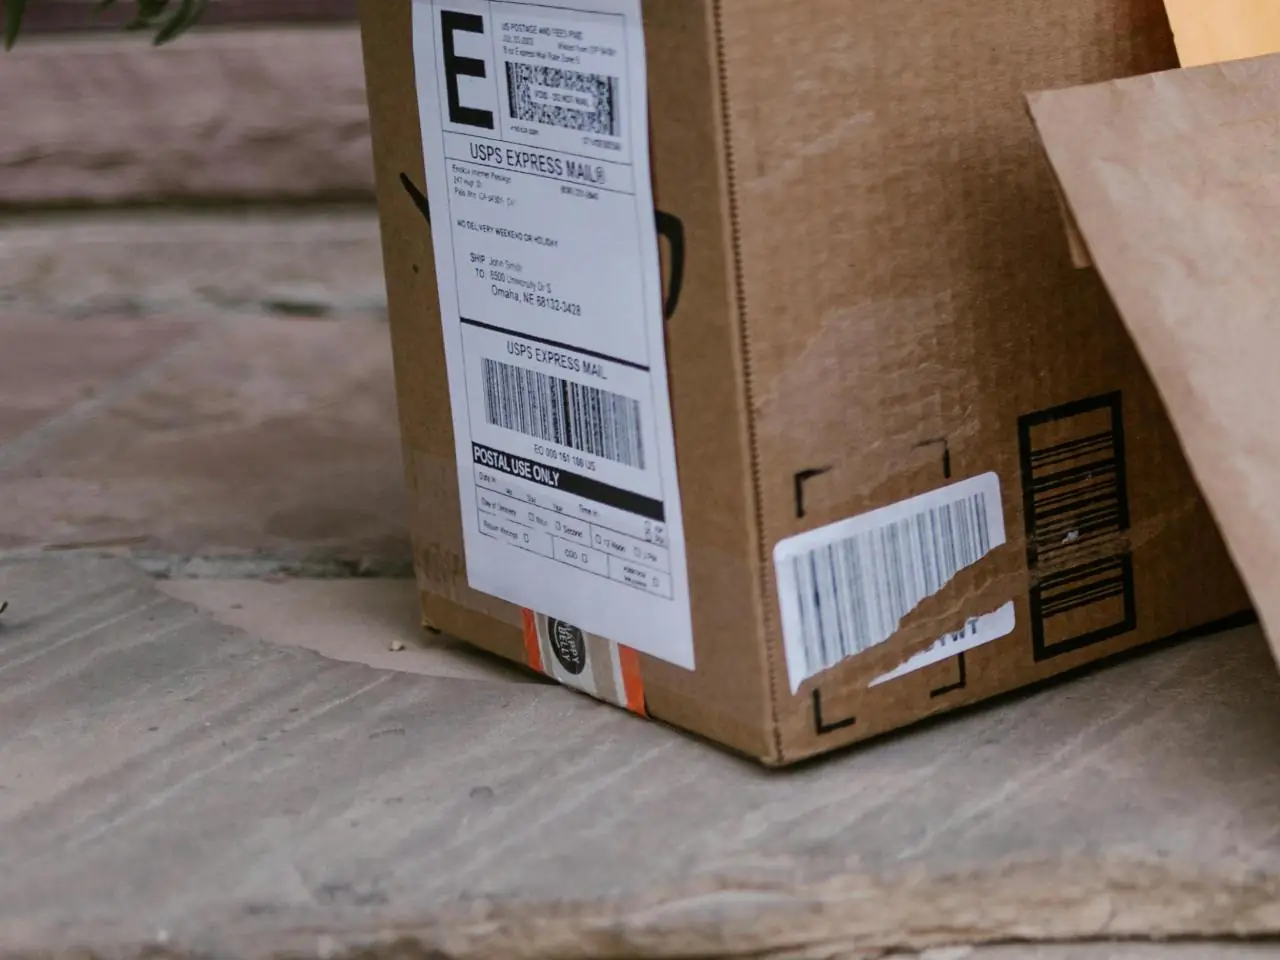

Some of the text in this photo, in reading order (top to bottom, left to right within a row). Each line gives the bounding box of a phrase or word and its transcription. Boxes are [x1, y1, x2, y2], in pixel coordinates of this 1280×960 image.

[440, 10, 495, 130] E
[470, 142, 503, 165] USPS
[506, 149, 564, 176] EXPRESS
[491, 285, 522, 303] Omaha,
[524, 292, 535, 305] NE
[507, 341, 607, 380] USPS EXPRESS MAIL
[474, 446, 561, 487] POSTAL USE ONLY
